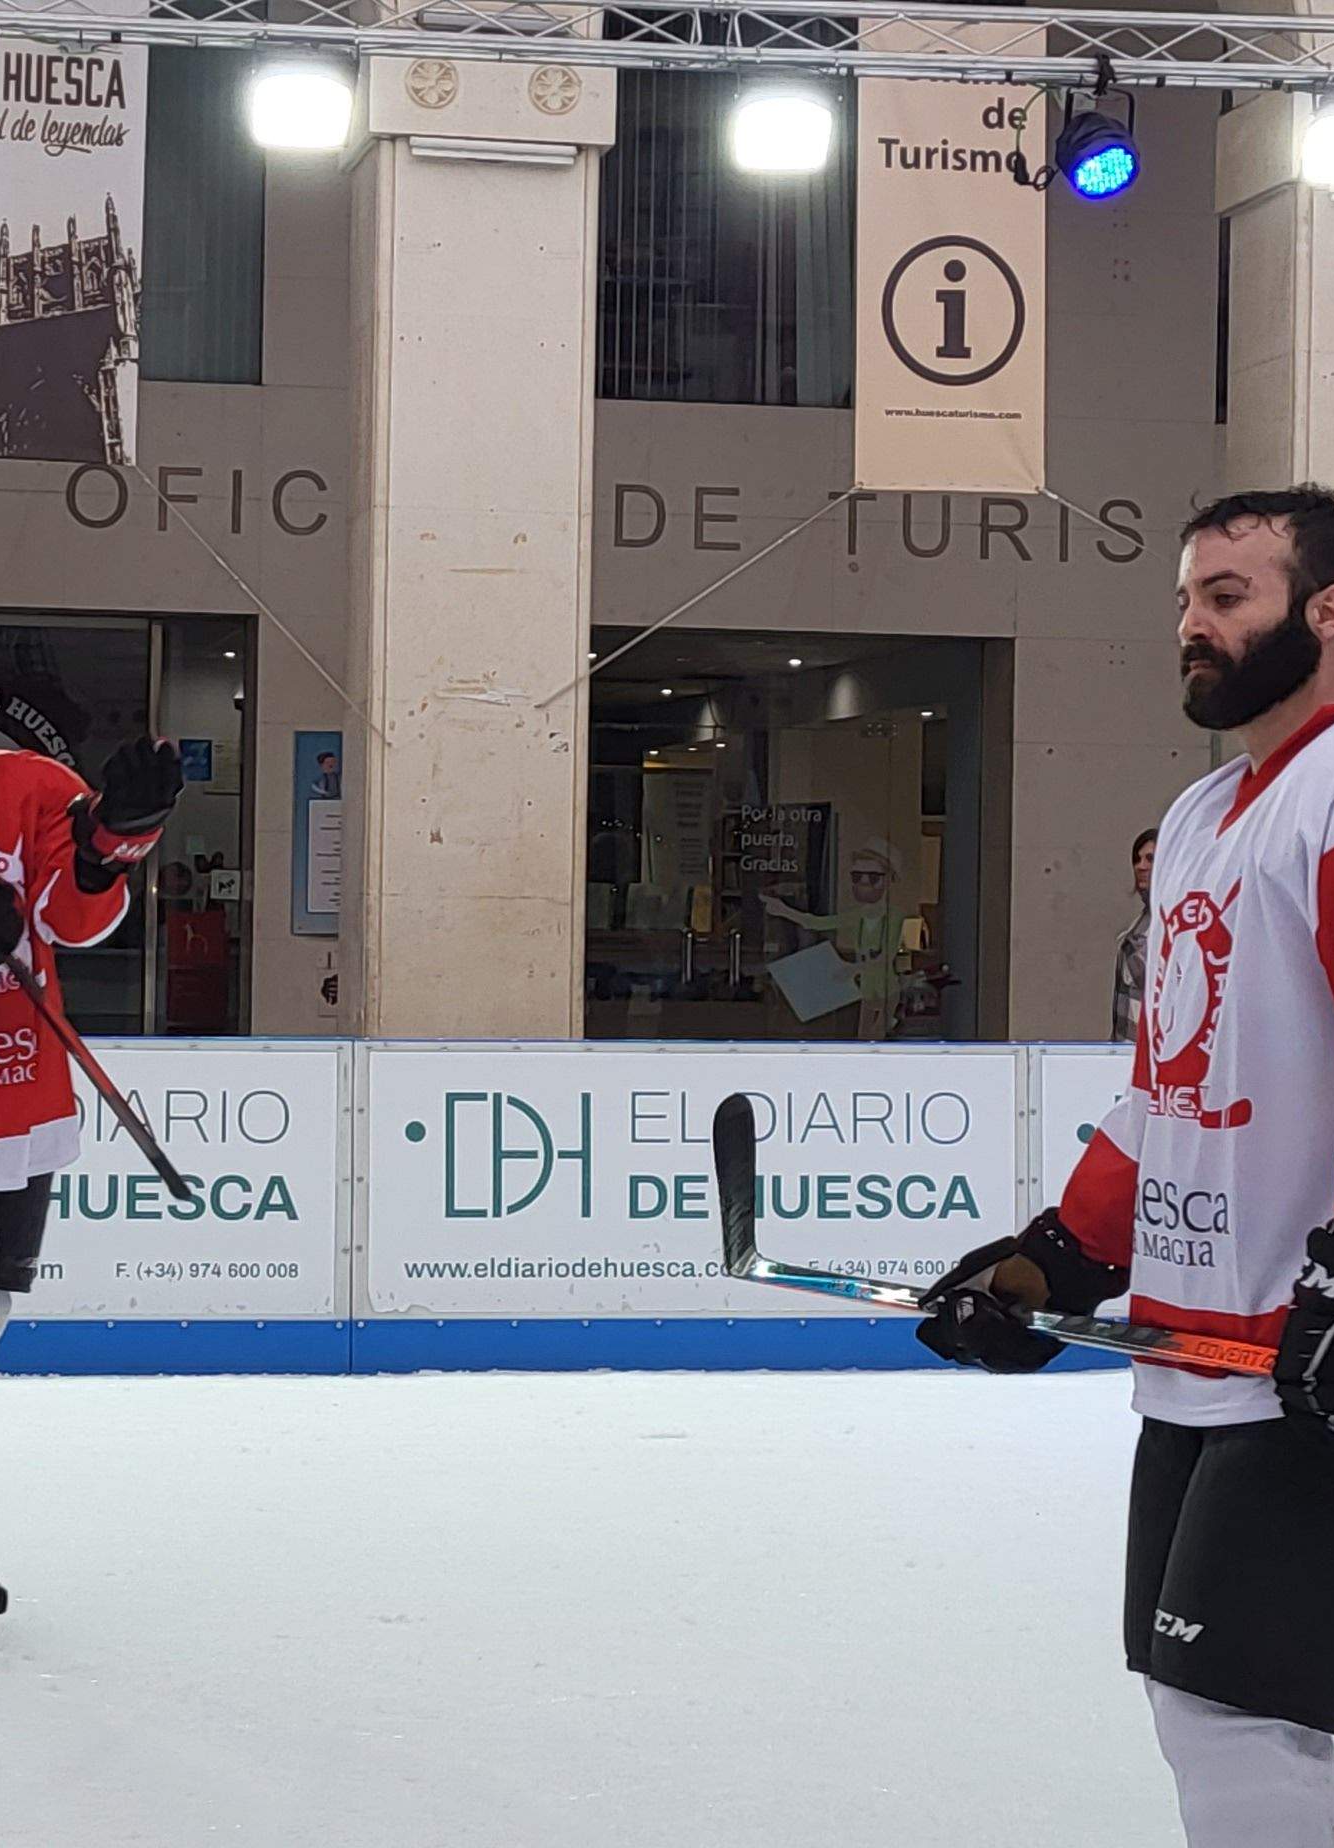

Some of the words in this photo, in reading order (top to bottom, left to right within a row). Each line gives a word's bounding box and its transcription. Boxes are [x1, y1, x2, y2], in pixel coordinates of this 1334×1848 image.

[3, 52, 126, 110] HUESCA
[982, 98, 1028, 131] de
[11, 109, 36, 142] de
[41, 109, 131, 157] leyendas
[878, 138, 1027, 174] Turismo
[885, 407, 1022, 421] www.huescaturismo.com
[613, 484, 741, 552] DE
[828, 490, 1146, 563] TURIS
[790, 807, 823, 822] otra
[740, 855, 799, 873] Gracias
[75, 1088, 291, 1145] IARIO
[629, 1091, 710, 1145] EL
[628, 1174, 709, 1220] DE
[115, 1262, 130, 1279] F.
[137, 1262, 184, 1281] (+34)
[190, 1263, 221, 1279] 974
[228, 1263, 260, 1279] 600
[266, 1263, 299, 1279] 008
[878, 1260, 908, 1275] 974
[914, 1260, 945, 1275] 600
